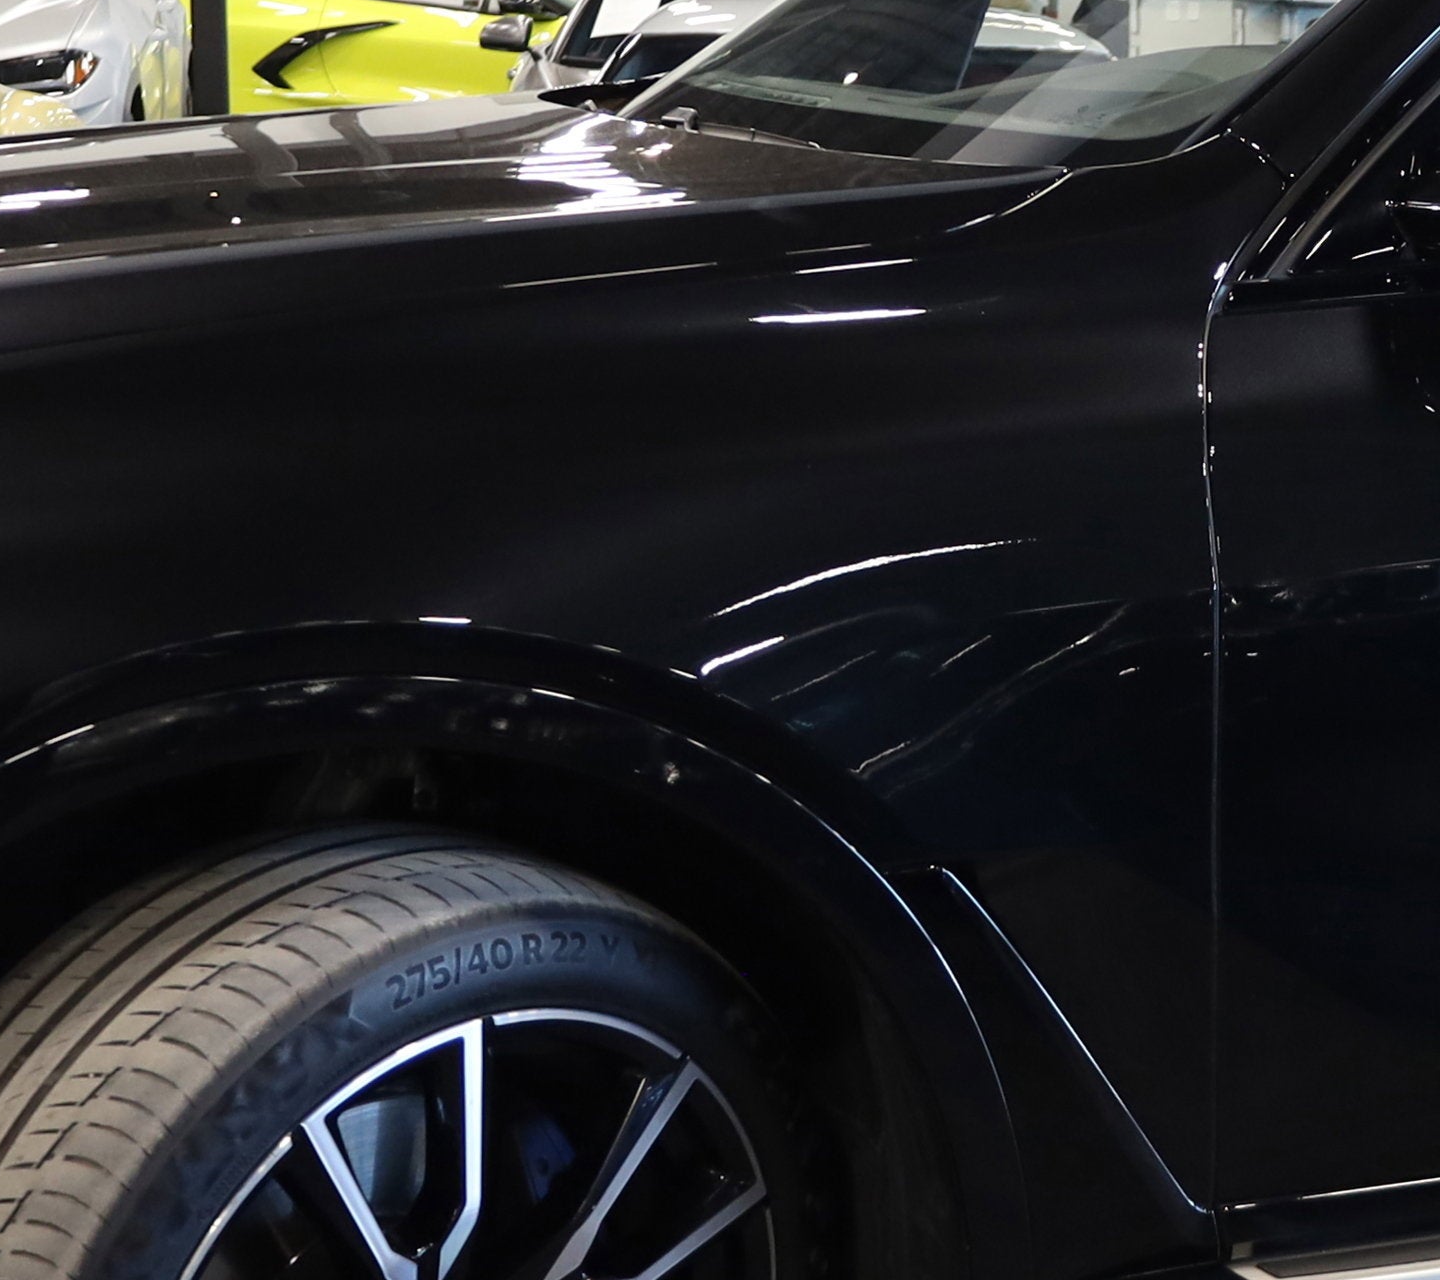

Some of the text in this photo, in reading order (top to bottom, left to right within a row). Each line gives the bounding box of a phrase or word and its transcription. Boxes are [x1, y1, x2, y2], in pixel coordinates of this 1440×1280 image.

[385, 937, 511, 1010] 275/40
[521, 932, 545, 965] R
[550, 930, 587, 963] 22
